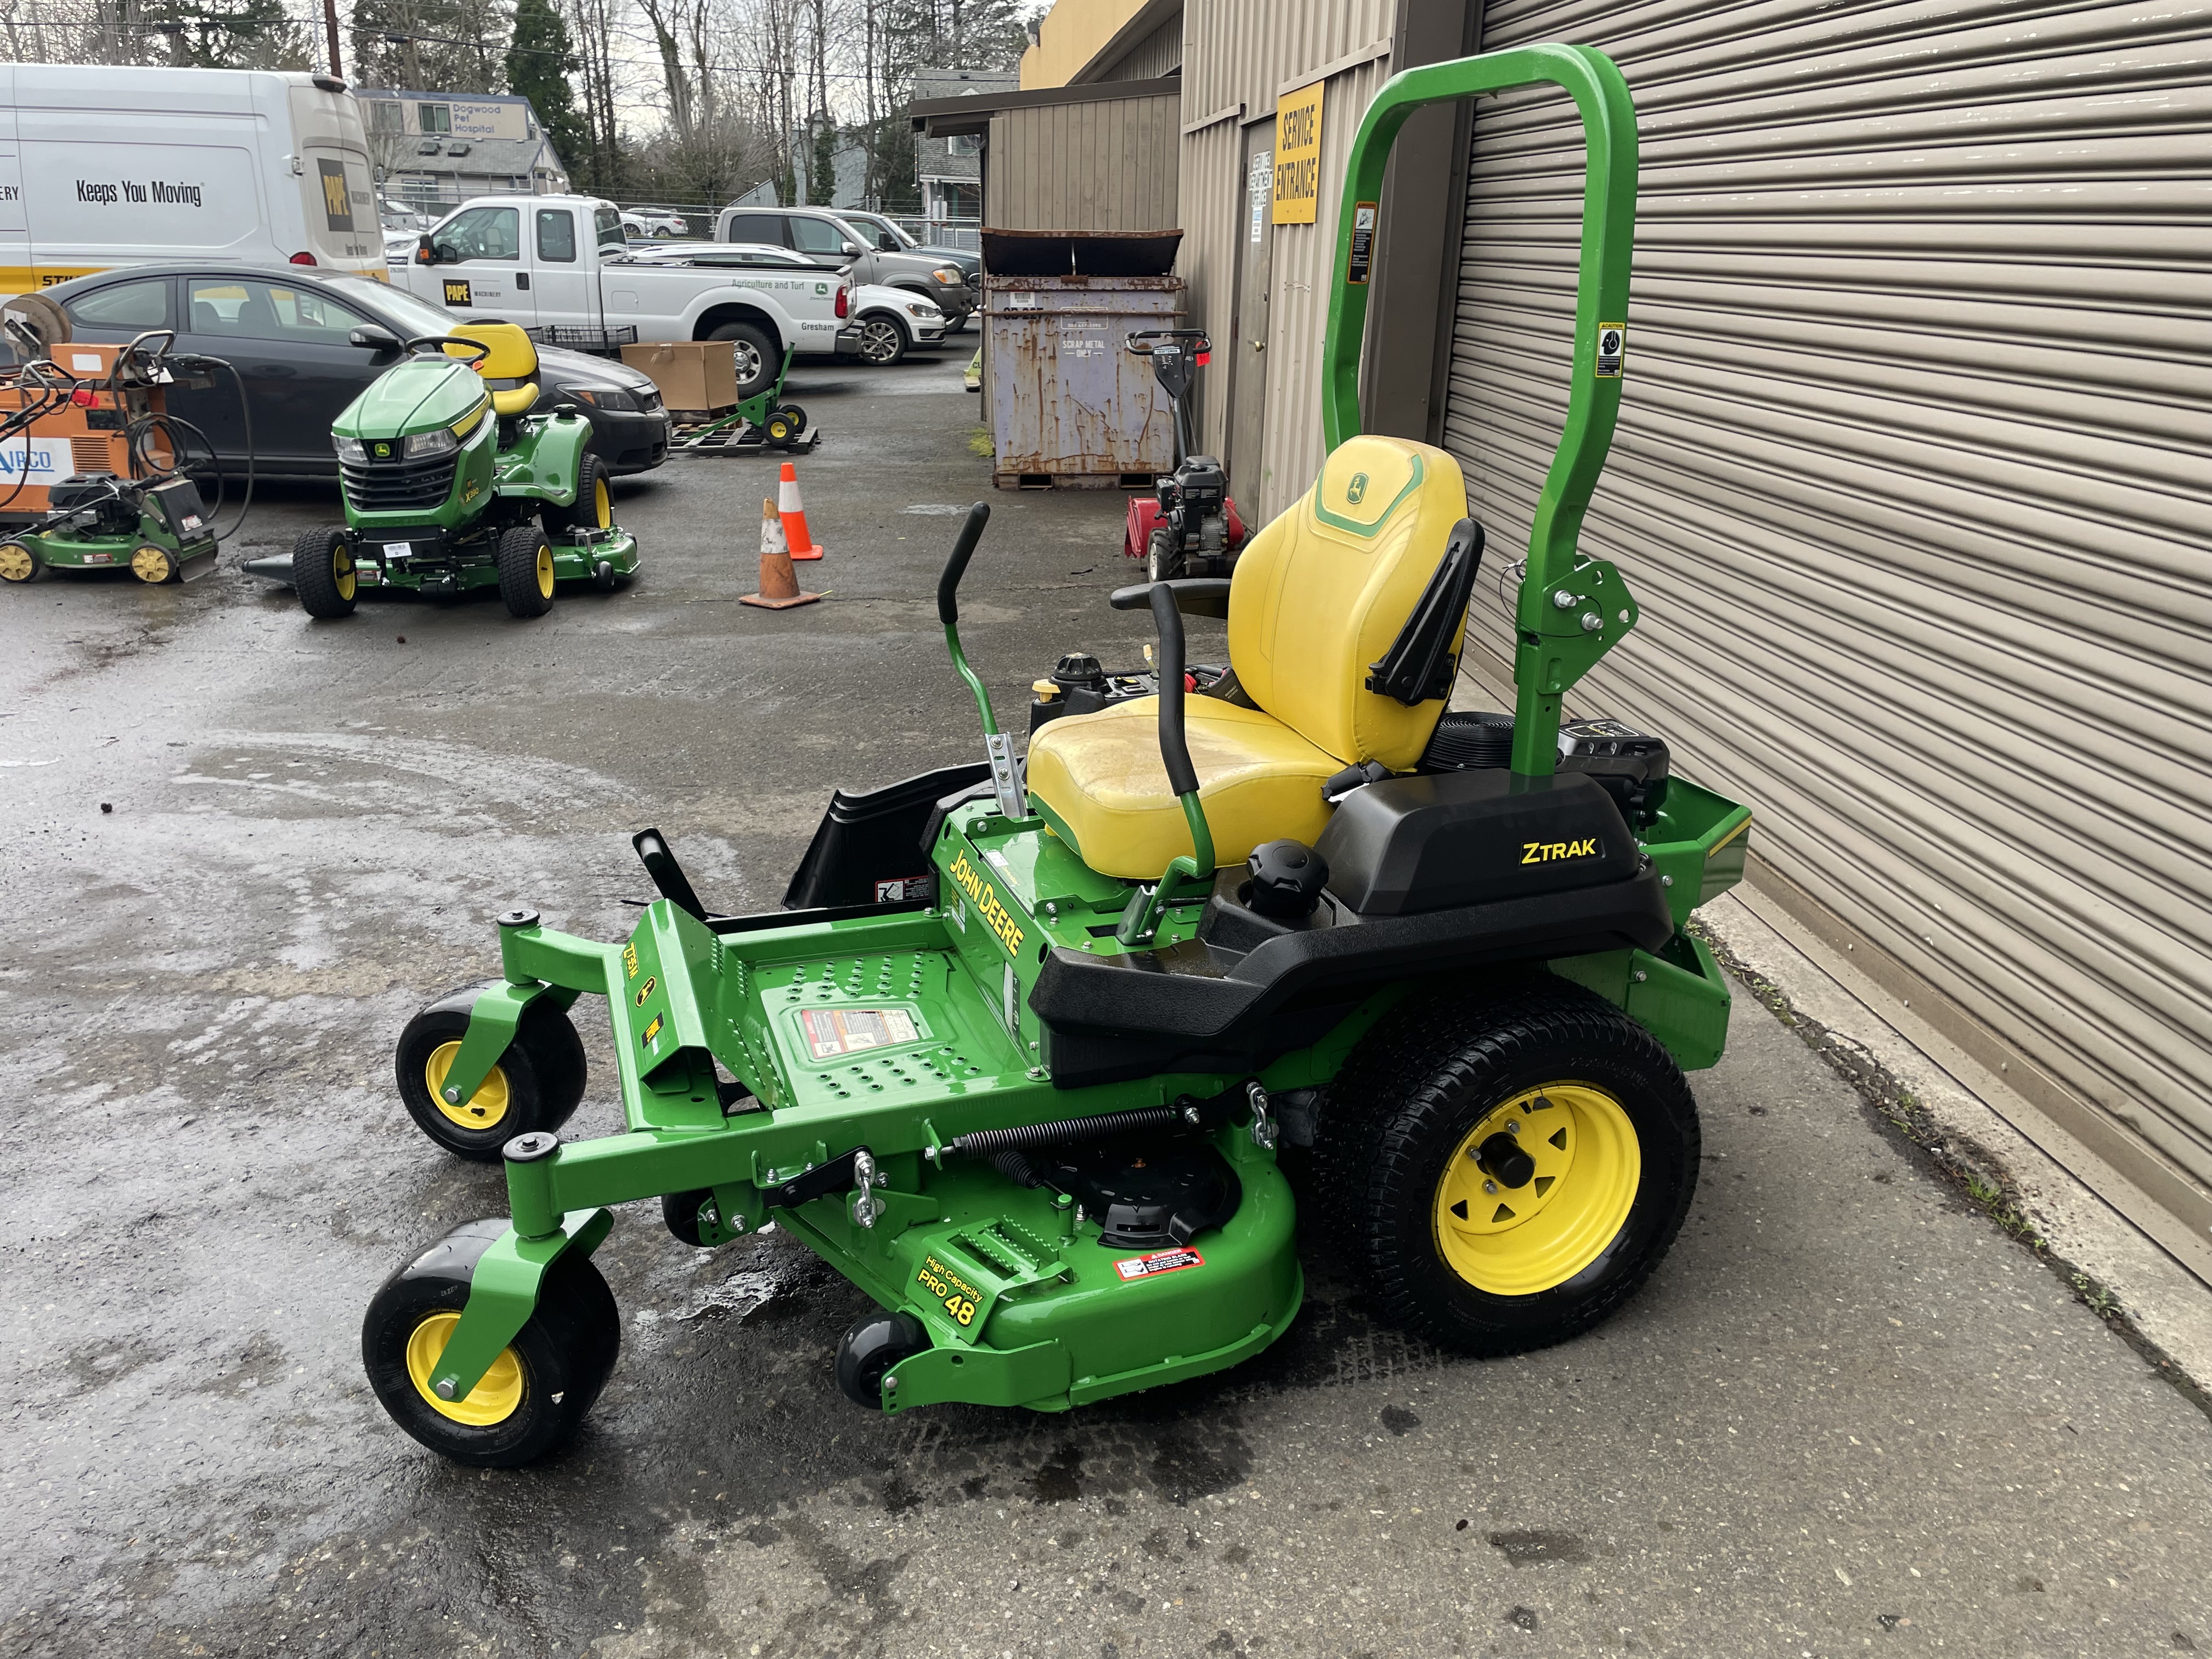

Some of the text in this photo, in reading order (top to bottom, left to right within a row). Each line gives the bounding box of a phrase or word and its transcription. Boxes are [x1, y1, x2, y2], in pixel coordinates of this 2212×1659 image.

[453, 104, 500, 114] Dogwood
[454, 114, 469, 122] Pet
[455, 124, 494, 134] Hospital
[1283, 104, 1315, 151] SERVICE
[1276, 157, 1316, 200] ENTRANCE
[77, 180, 201, 207] Keeps You Moving
[732, 279, 772, 289] Agriculture
[791, 281, 804, 290] Turf
[802, 323, 834, 331] Gresham
[1063, 340, 1105, 348] SCRAP METAL
[1521, 838, 1596, 864] ZTRAK
[950, 847, 984, 905] JOHN
[978, 881, 1025, 959] DEERE
[1157, 1249, 1182, 1257] DANGER
[926, 1255, 984, 1303] High Capacity
[917, 1267, 976, 1327] PRO 48
